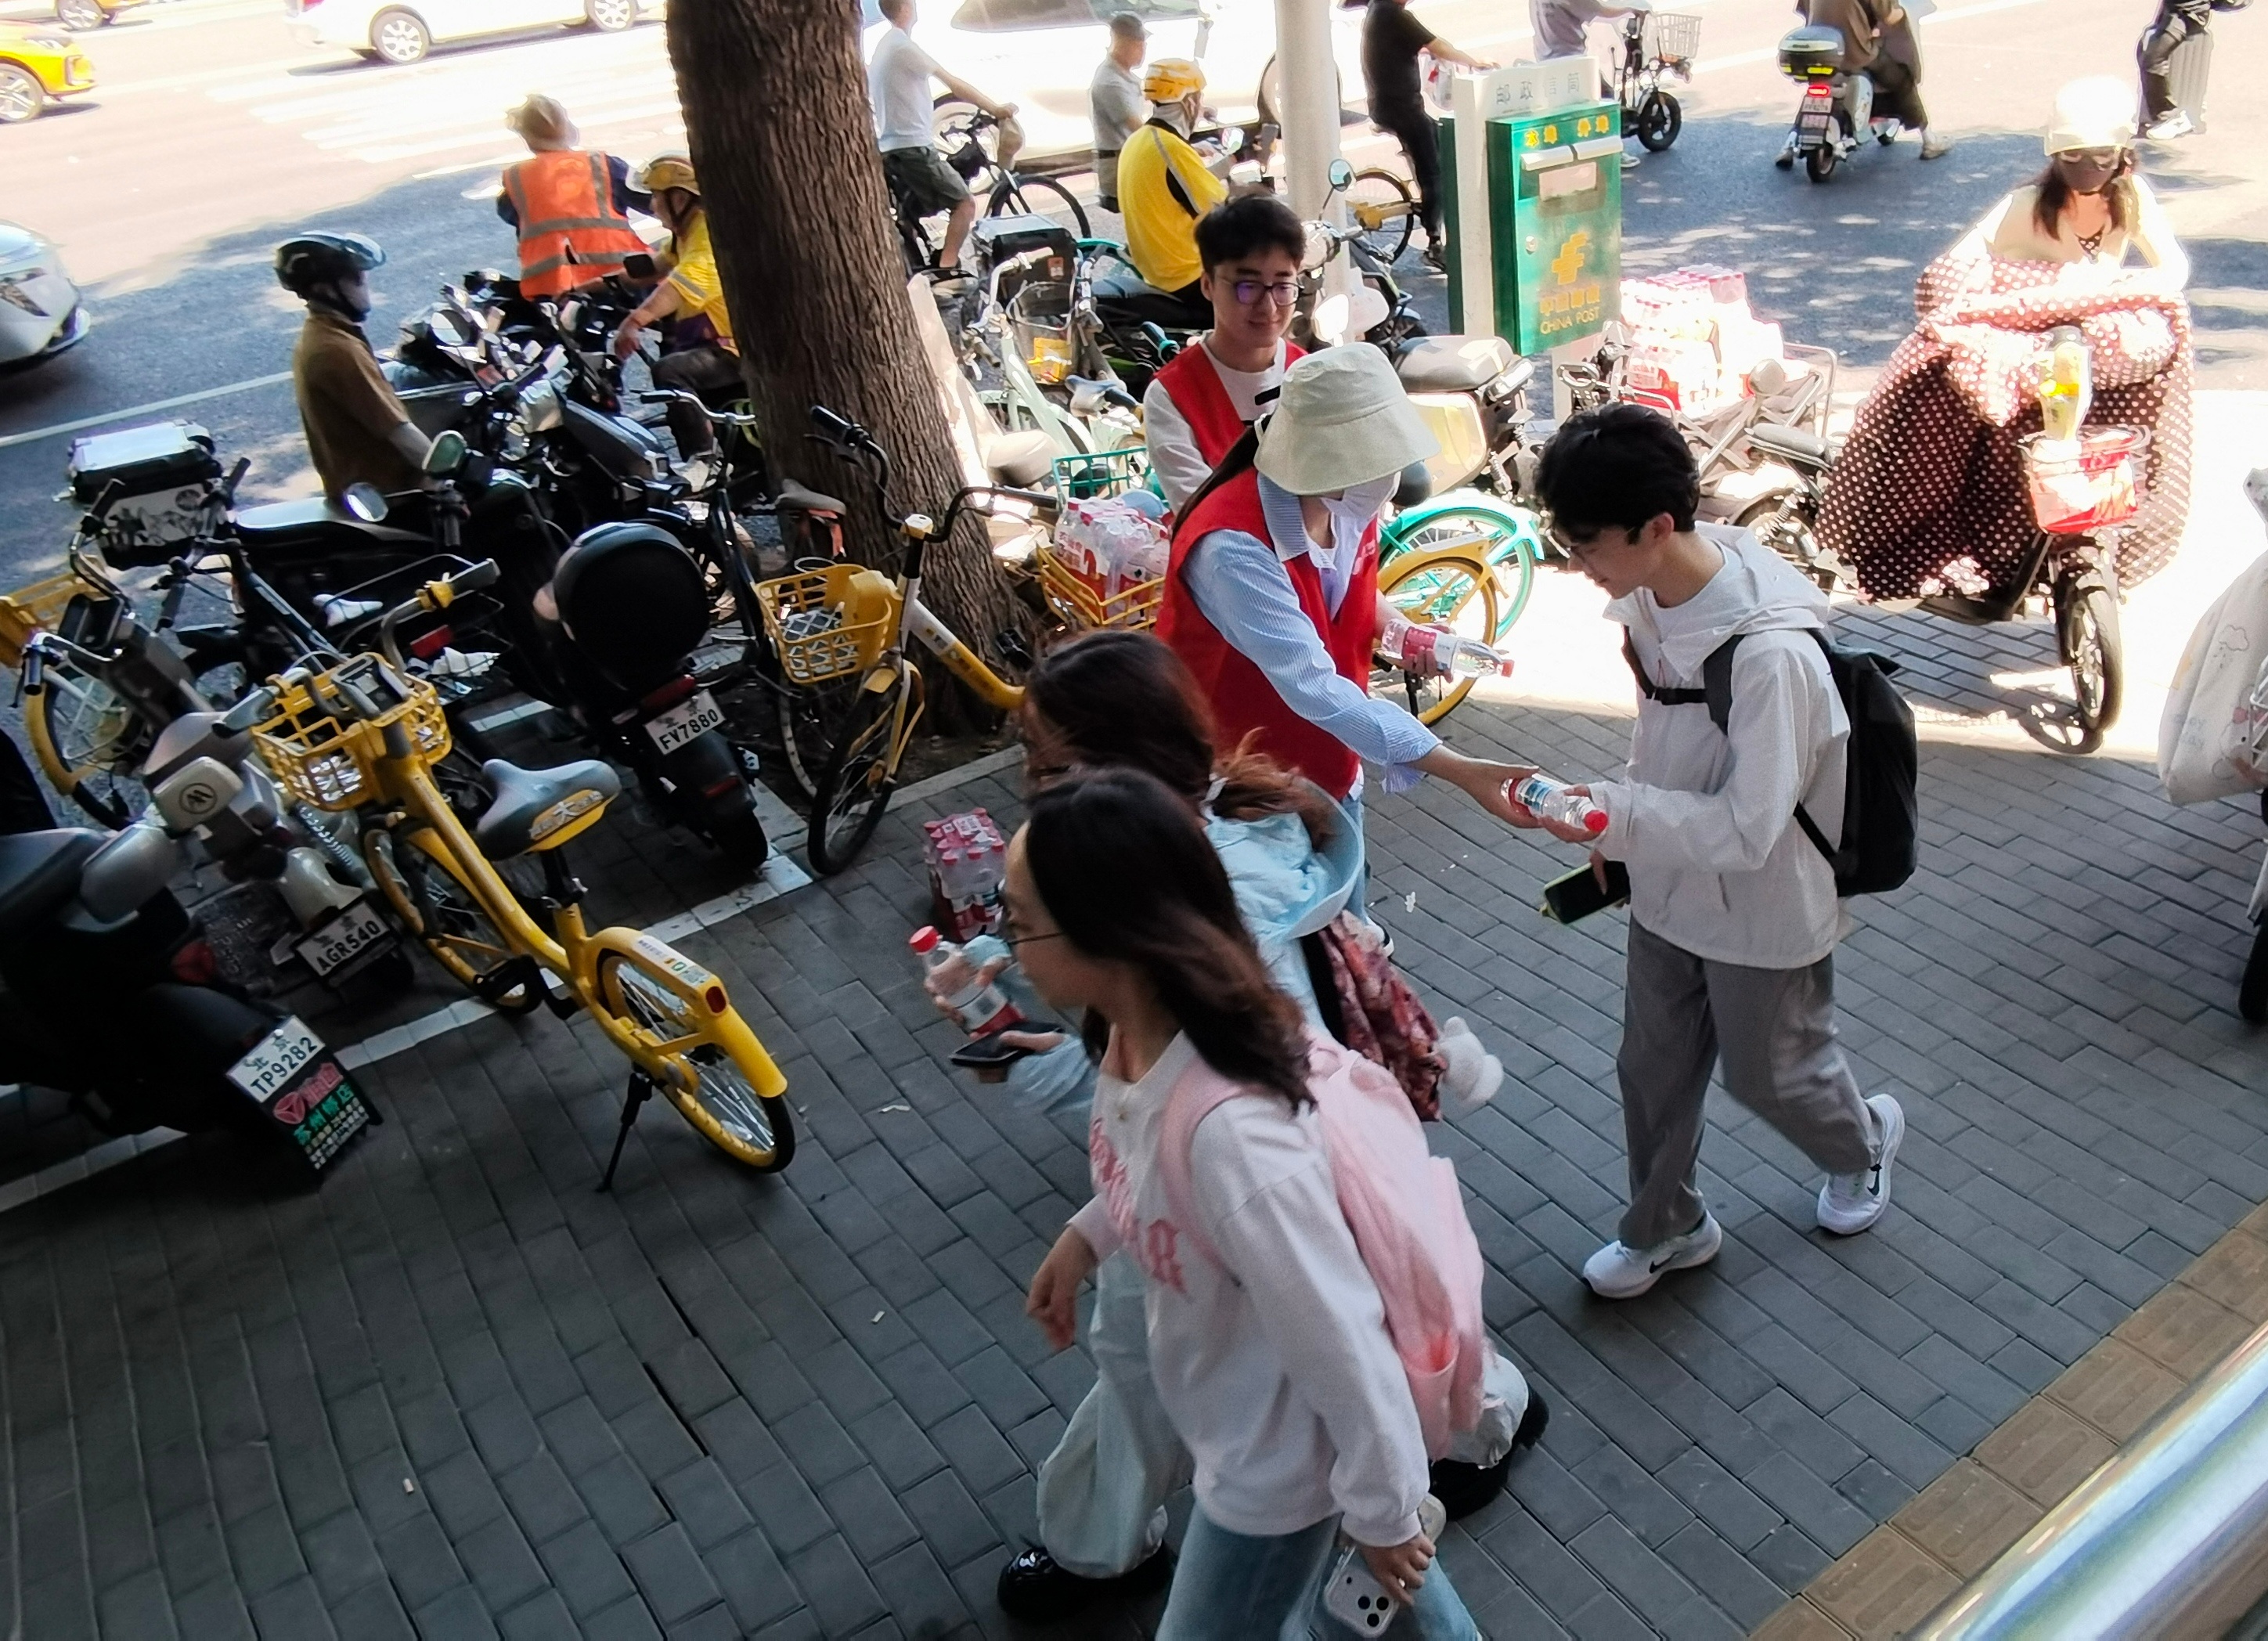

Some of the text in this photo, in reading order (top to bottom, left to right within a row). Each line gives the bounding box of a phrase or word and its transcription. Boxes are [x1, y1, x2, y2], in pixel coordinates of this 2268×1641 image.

[1496, 72, 1580, 105] 邮政信筒
[1540, 306, 1599, 335] CHINA POST
[658, 709, 719, 750] FV7880
[251, 1037, 318, 1094] TP9282
